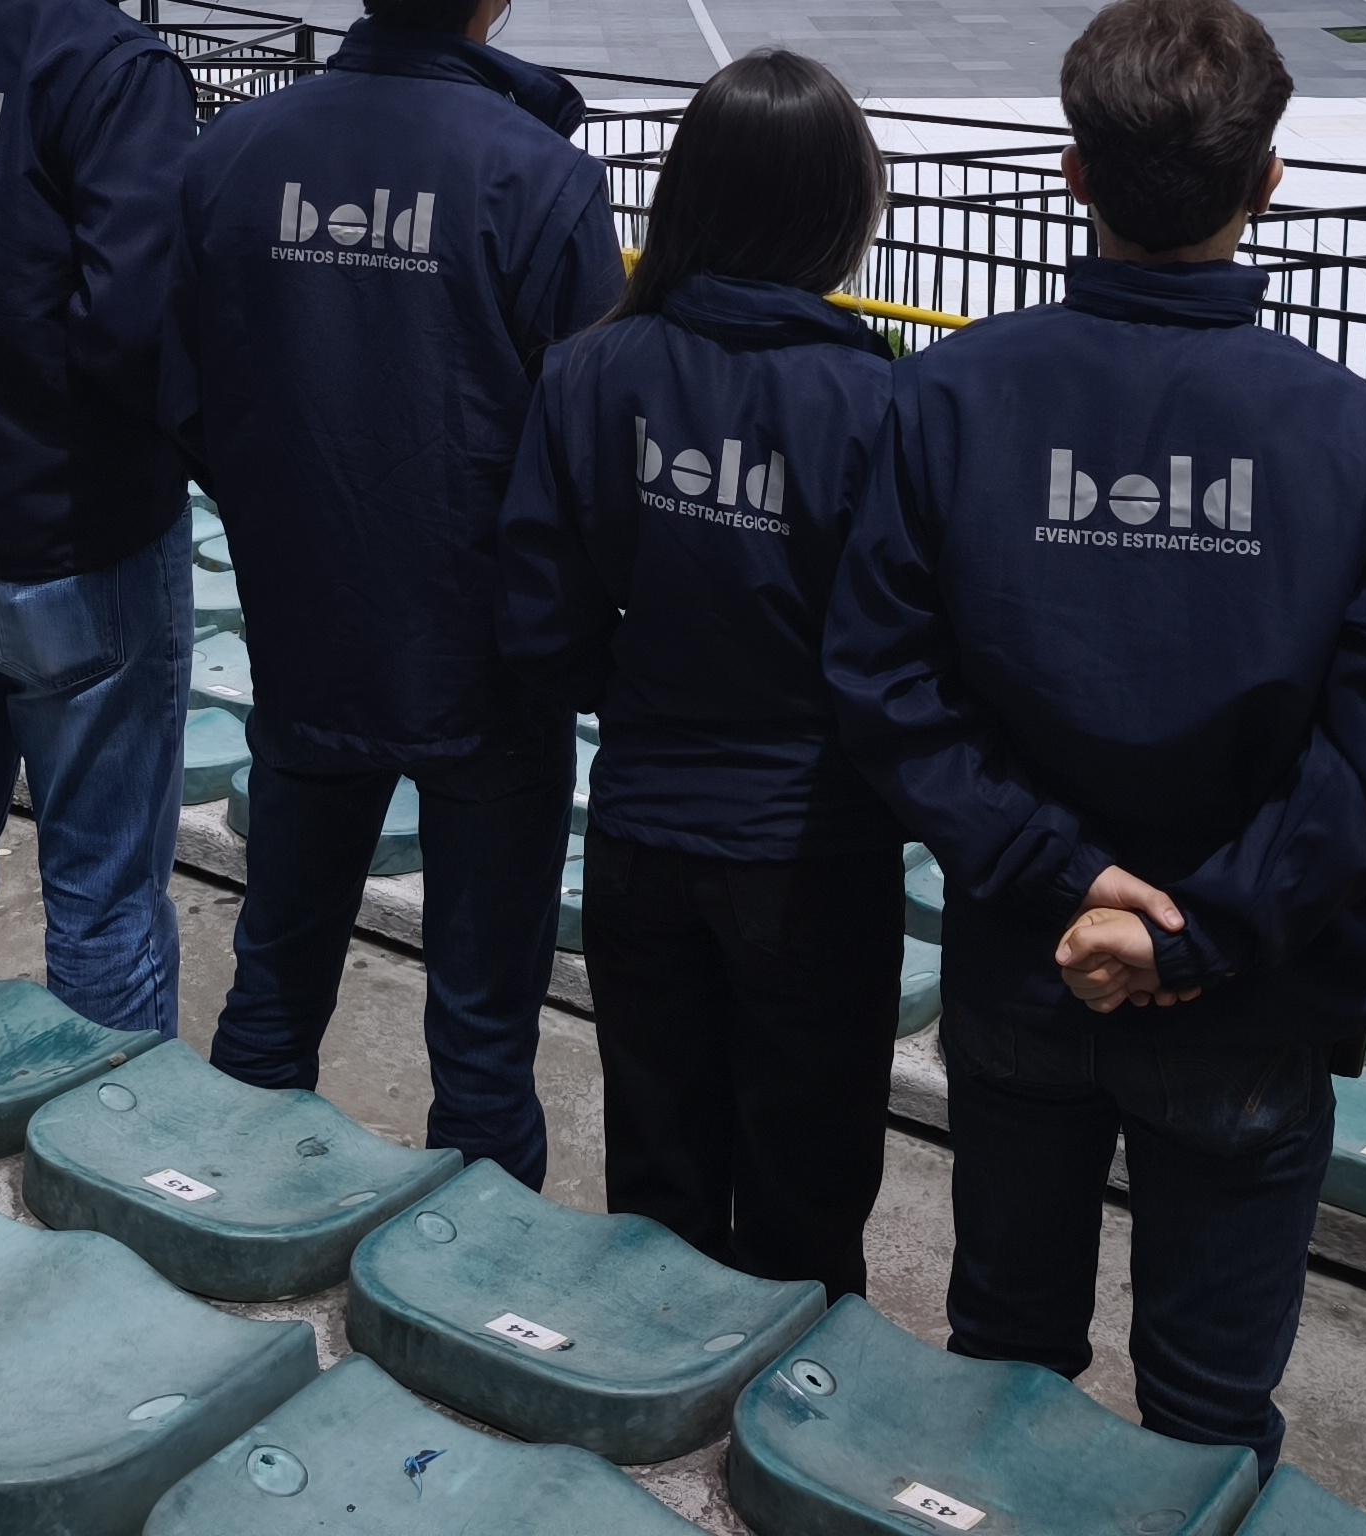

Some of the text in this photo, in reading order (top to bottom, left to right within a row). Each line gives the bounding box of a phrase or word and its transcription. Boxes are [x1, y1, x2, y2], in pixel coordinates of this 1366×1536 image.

[279, 181, 435, 254] bold
[271, 246, 438, 274] EVENTOS ESTRATÉGICOS
[635, 415, 785, 515] bold
[1048, 448, 1253, 532] bold
[678, 500, 790, 536] ESTRATÉGICOS
[1035, 526, 1261, 556] EVENTOS ESTRATÉGICOS
[163, 1179, 195, 1193] 45
[506, 1324, 541, 1340] 44
[919, 1498, 959, 1517] 43
